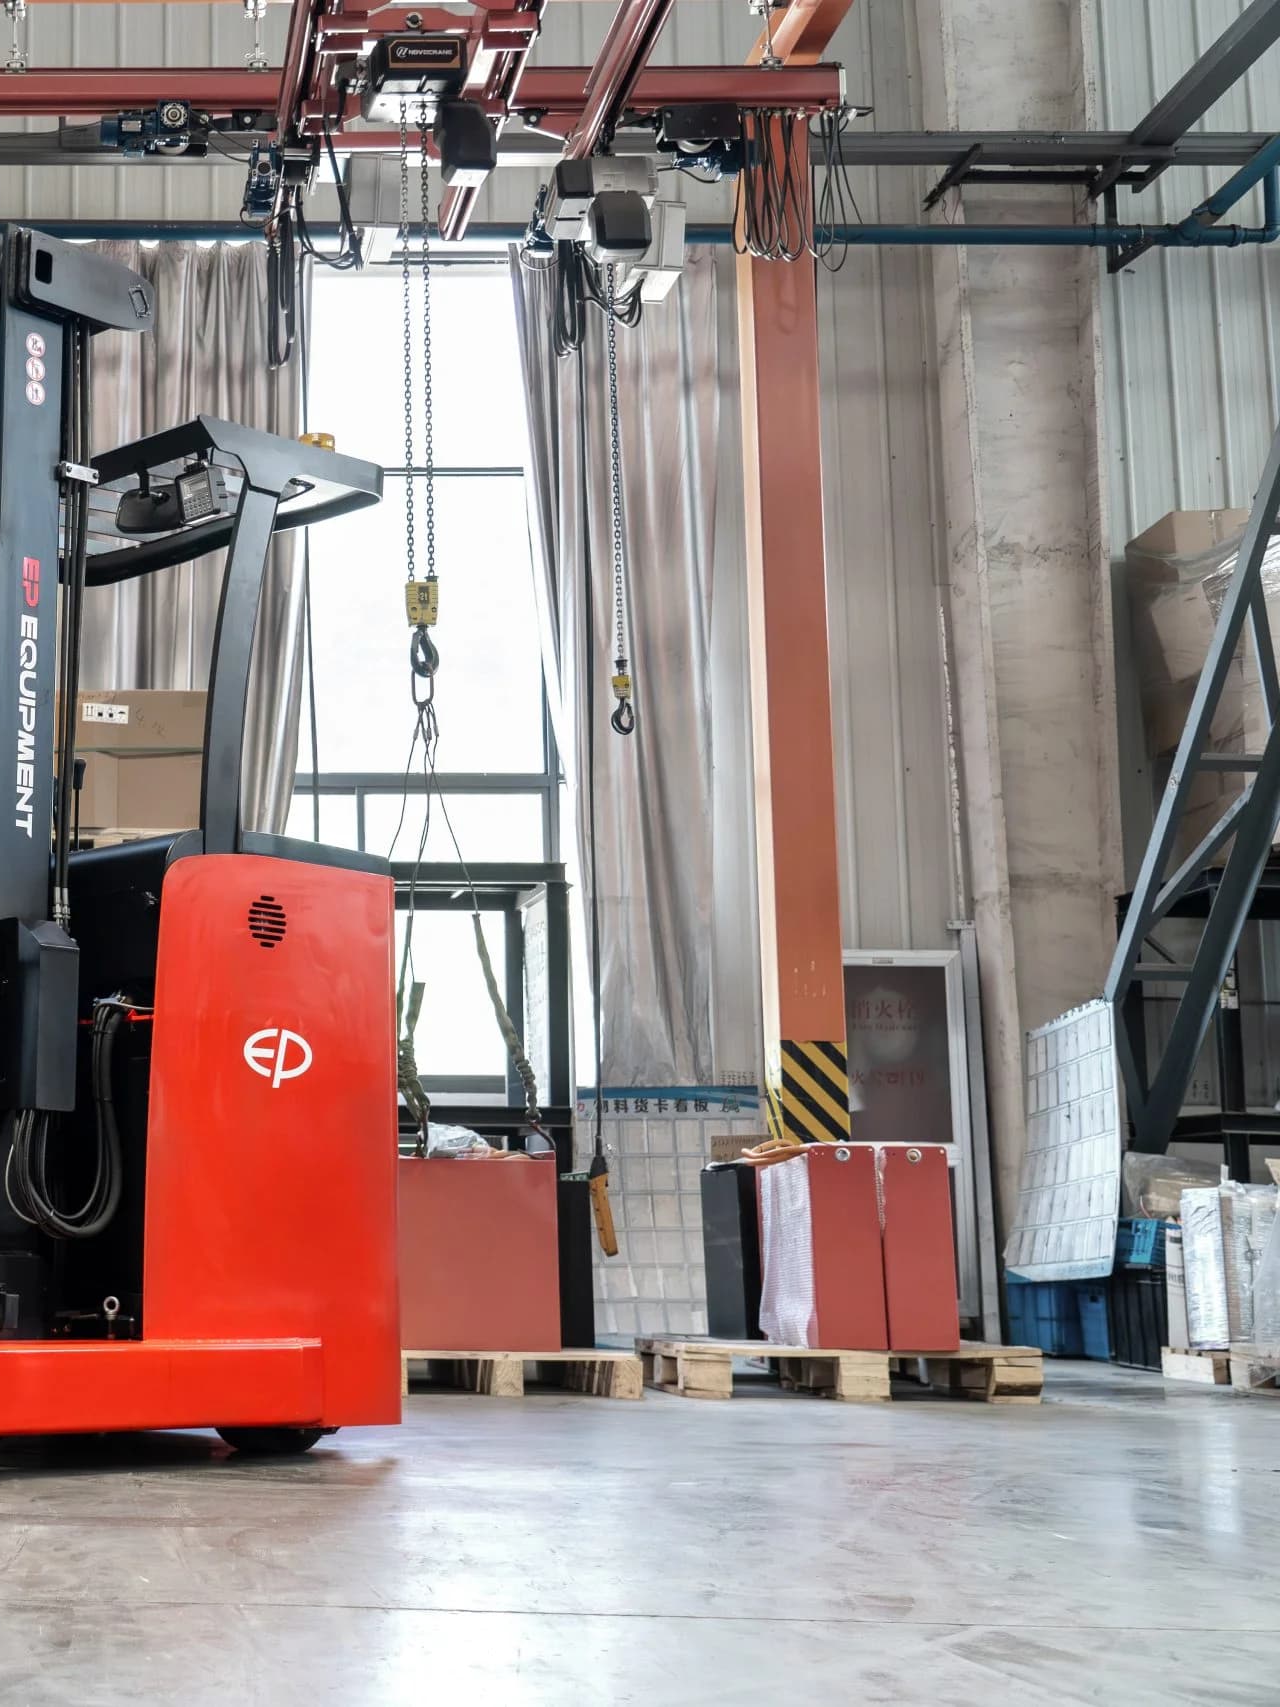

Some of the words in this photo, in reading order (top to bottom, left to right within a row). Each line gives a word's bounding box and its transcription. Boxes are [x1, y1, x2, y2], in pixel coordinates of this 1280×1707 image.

[22, 556, 40, 608] EP
[15, 614, 38, 839] EQUIPMENT
[243, 1028, 313, 1089] EP
